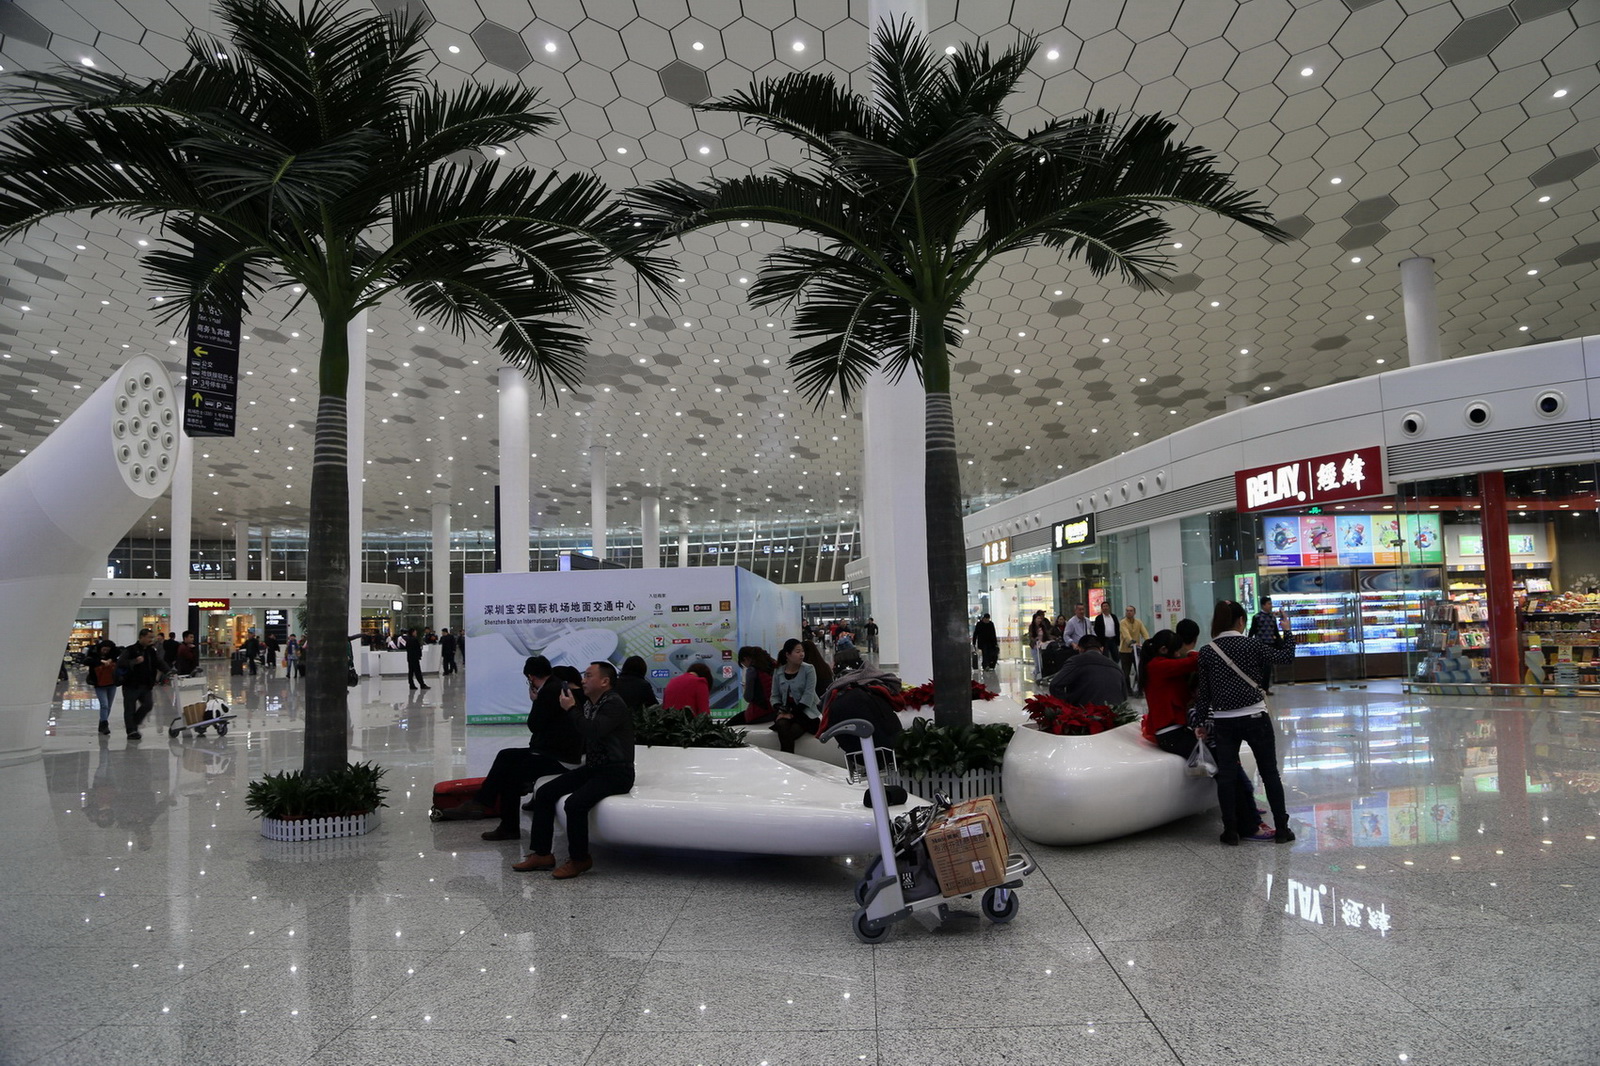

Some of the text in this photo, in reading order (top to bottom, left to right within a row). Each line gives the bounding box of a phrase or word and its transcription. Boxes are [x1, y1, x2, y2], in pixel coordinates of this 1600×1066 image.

[484, 600, 636, 615] 深圳宝安国际机场地面交通中心
